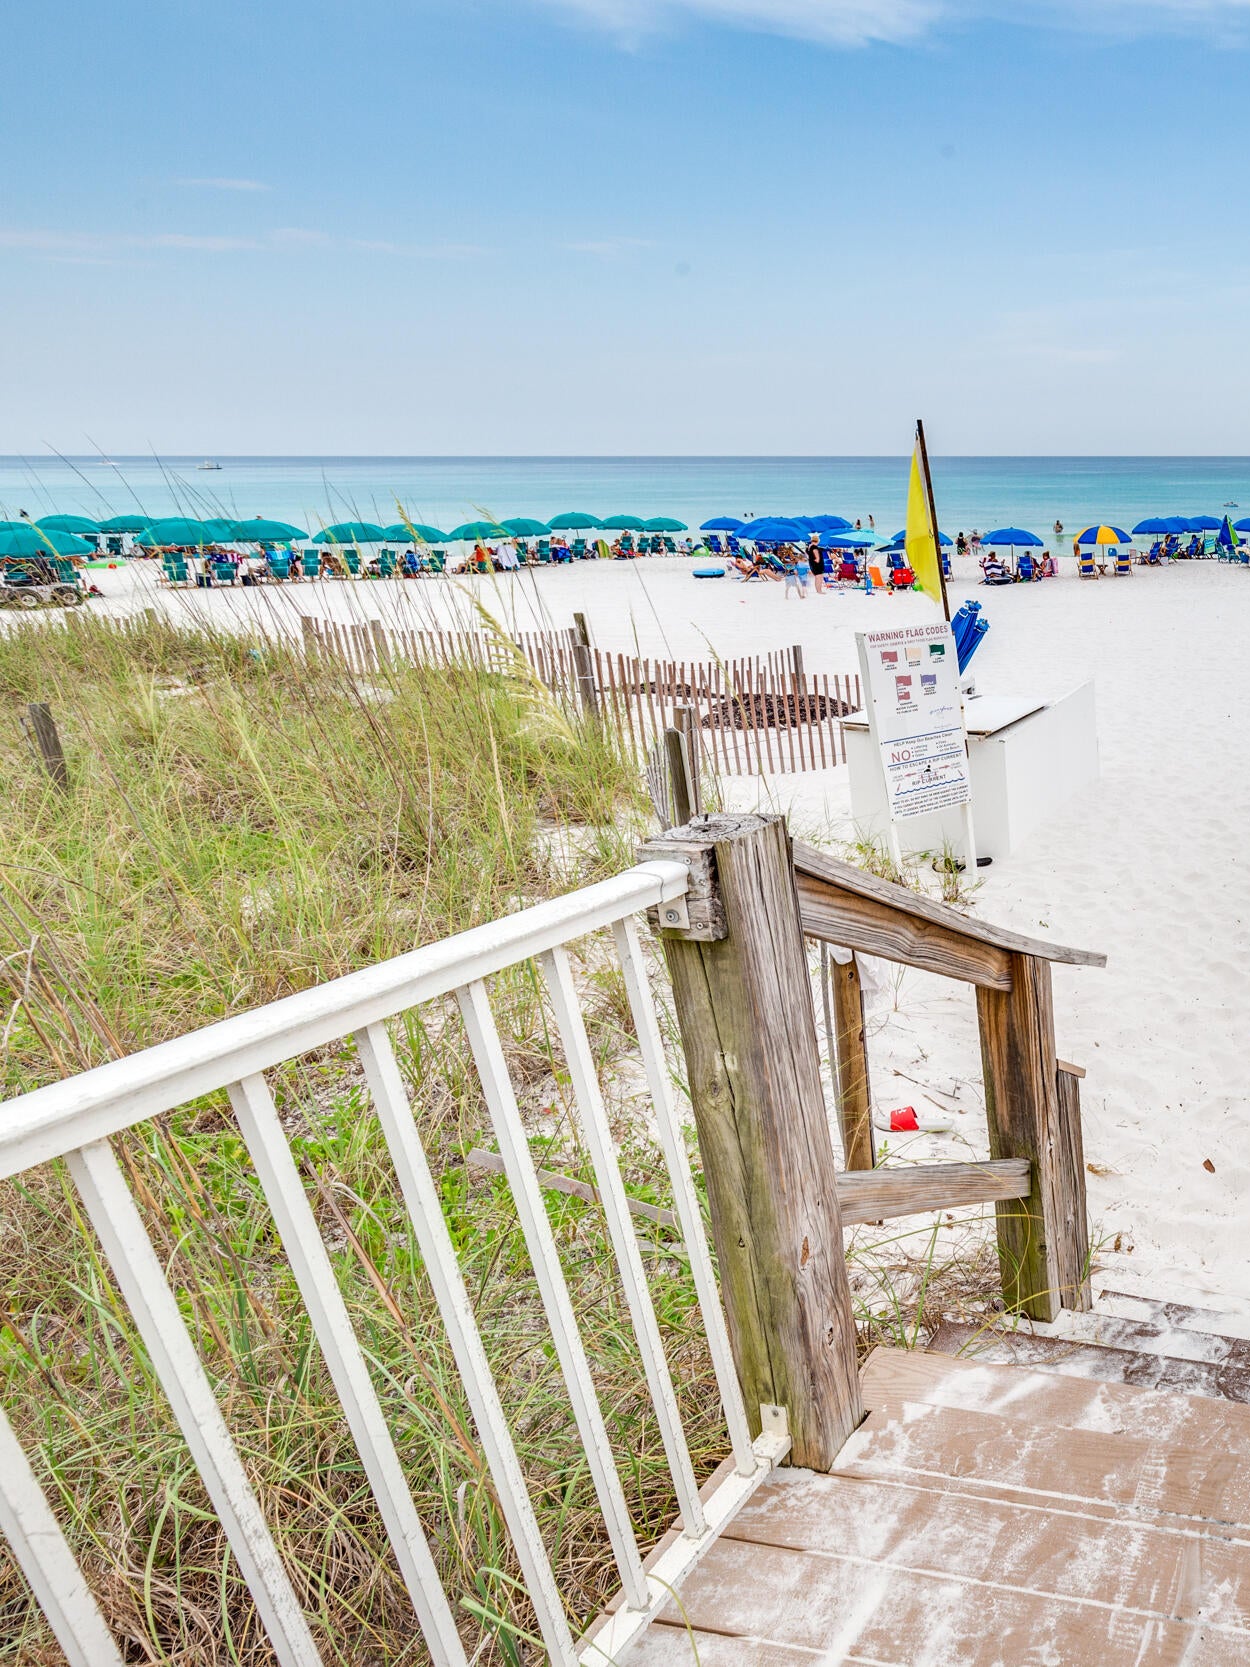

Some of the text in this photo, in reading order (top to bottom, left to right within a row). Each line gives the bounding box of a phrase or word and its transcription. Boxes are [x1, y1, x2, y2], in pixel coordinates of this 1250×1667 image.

[868, 630, 904, 643] WARNING
[905, 628, 924, 638] FLAG
[925, 625, 949, 636] CODES
[891, 750, 911, 763] NO
[921, 774, 946, 784] CURRENT
